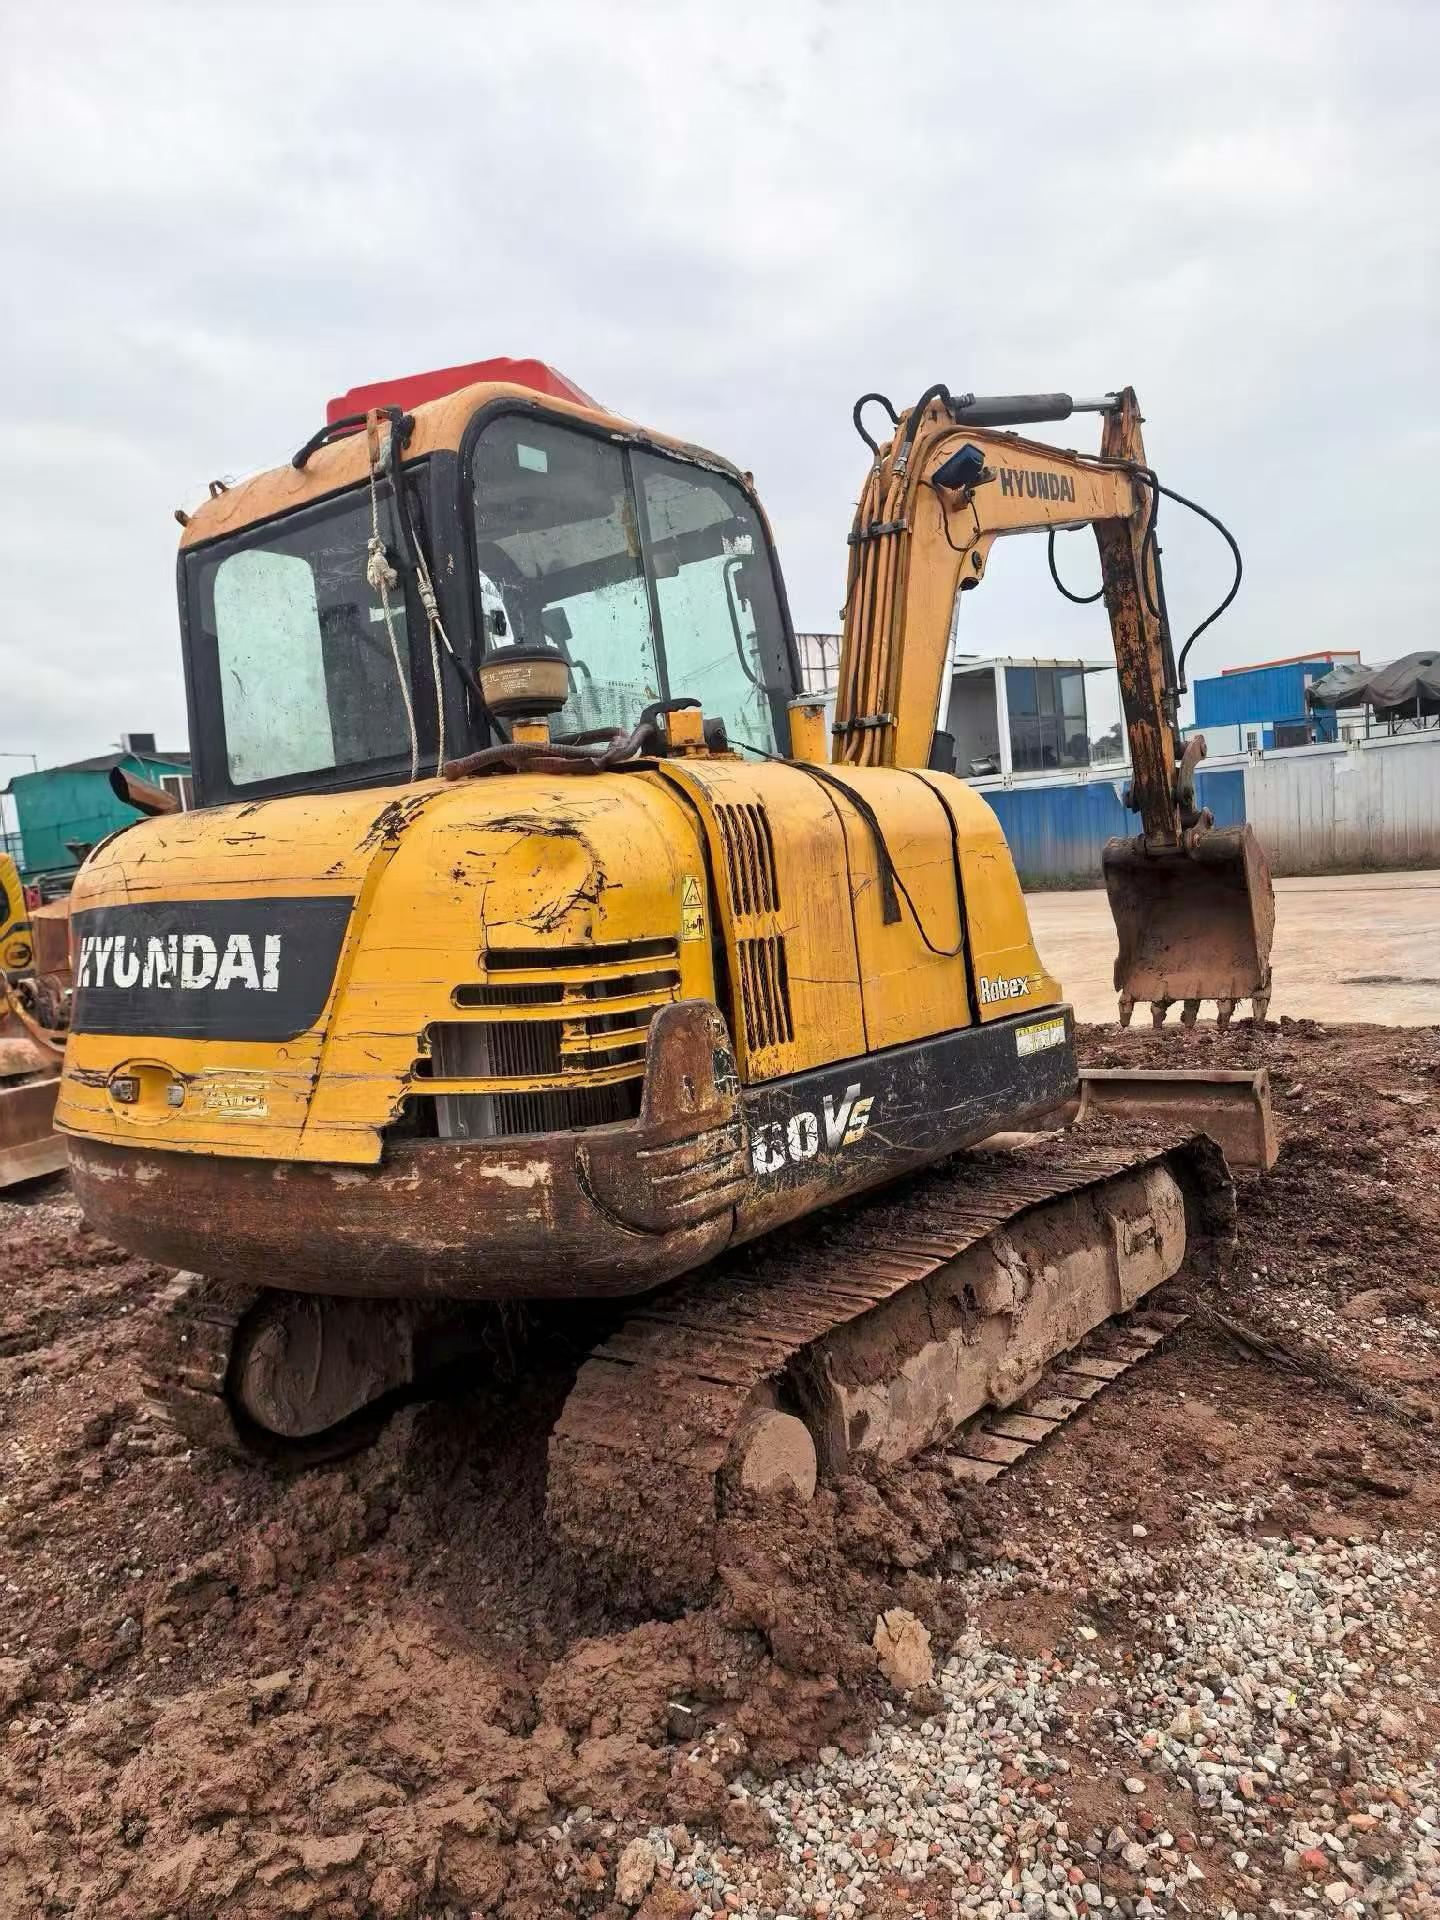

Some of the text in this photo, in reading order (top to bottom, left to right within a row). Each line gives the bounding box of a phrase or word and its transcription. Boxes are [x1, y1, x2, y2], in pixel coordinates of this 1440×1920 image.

[999, 468, 1076, 503] HYUNDAI
[77, 934, 282, 992] HYUNDAI
[980, 975, 1031, 1004] Robex
